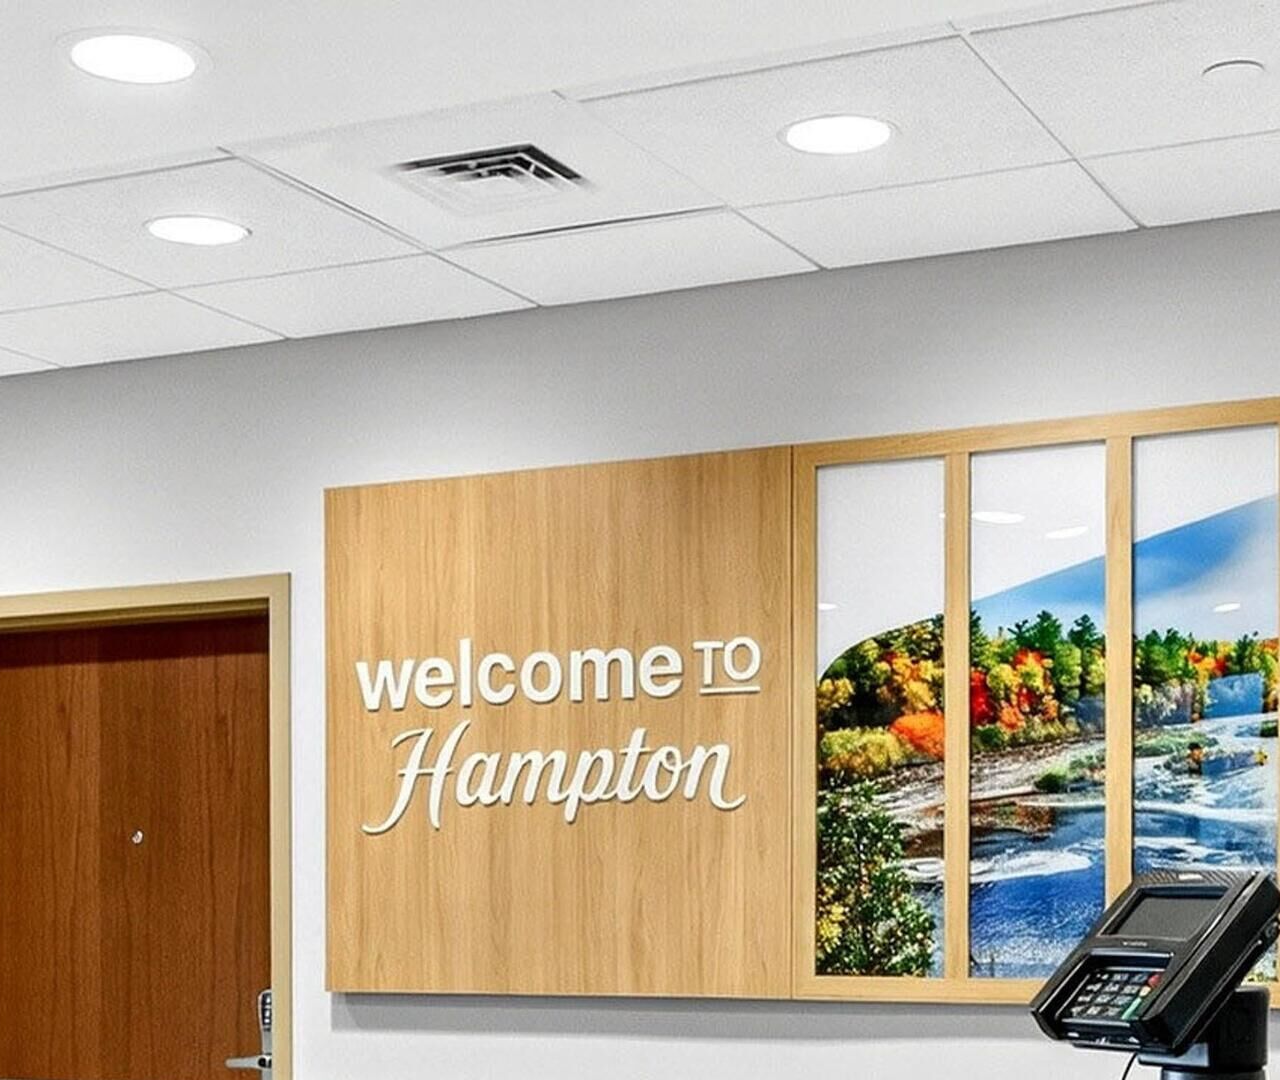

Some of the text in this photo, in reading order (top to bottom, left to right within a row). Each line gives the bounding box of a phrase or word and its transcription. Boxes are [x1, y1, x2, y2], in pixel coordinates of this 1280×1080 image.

[355, 636, 761, 711] welcome TO
[361, 719, 748, 834] Hampton
